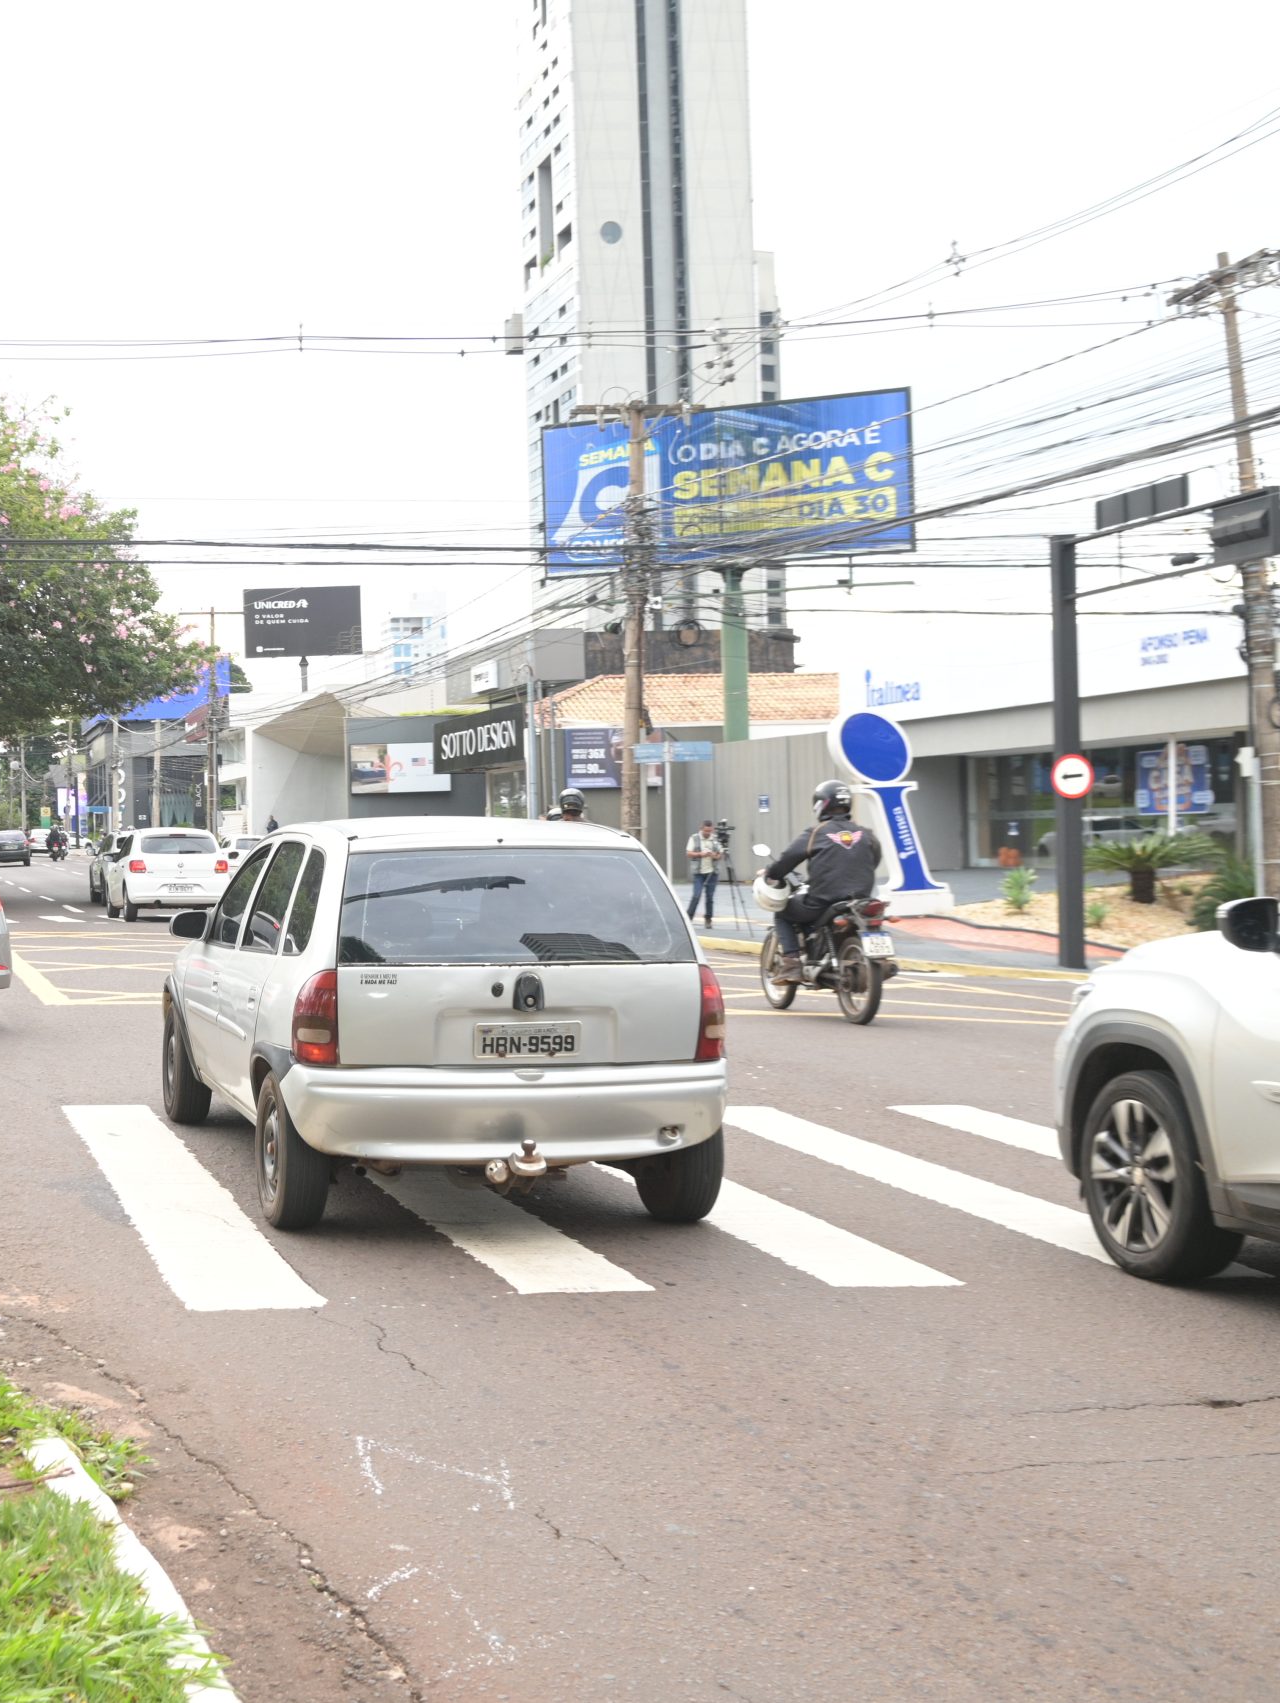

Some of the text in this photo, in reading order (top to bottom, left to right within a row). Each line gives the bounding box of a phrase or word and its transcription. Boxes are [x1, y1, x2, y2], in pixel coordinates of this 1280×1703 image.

[700, 438, 747, 461] DIA
[752, 437, 771, 456] C
[776, 428, 862, 454] AGORA
[673, 451, 896, 500] SEMANA C
[254, 601, 296, 610] UNICRED
[441, 720, 517, 760] SOTTO DESIGN
